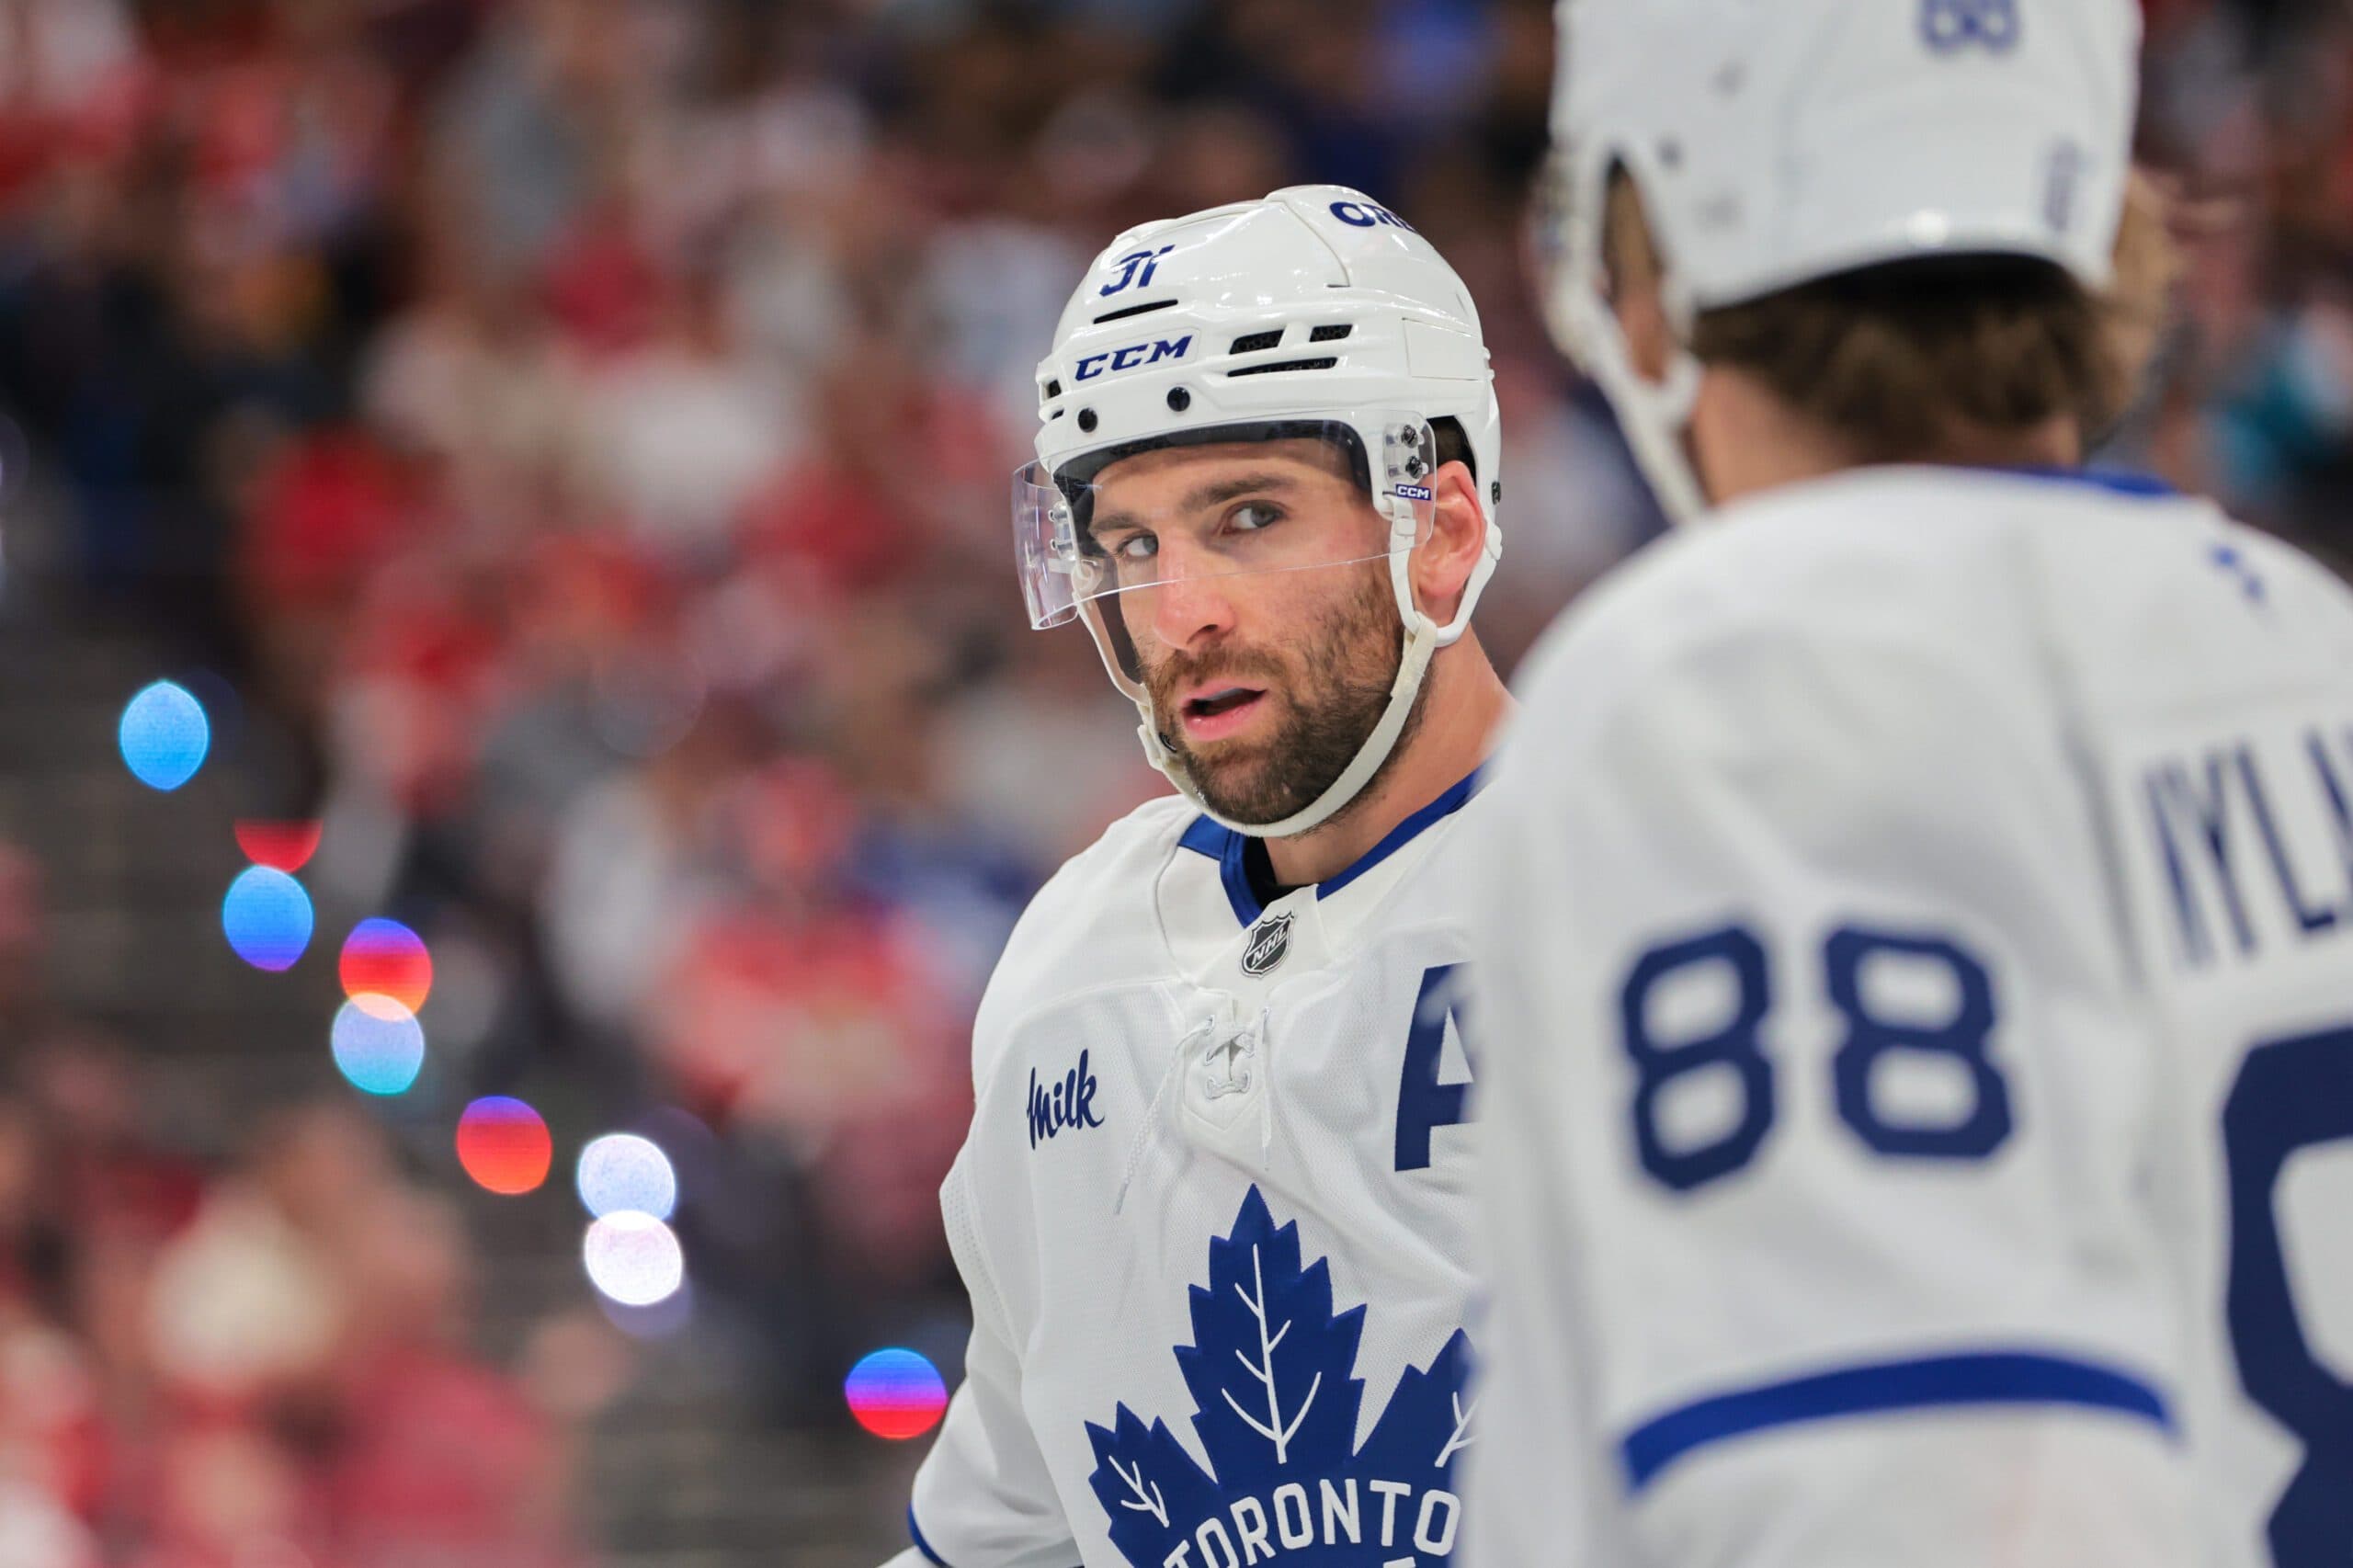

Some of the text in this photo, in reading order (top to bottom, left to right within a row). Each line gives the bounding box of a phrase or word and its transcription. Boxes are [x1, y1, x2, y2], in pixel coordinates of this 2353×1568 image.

[1074, 335, 1193, 381] CCM
[1397, 485, 1430, 499] CCM
[1251, 926, 1287, 967] NHL
[1393, 960, 1478, 1172] A
[1621, 926, 2013, 1191] 88
